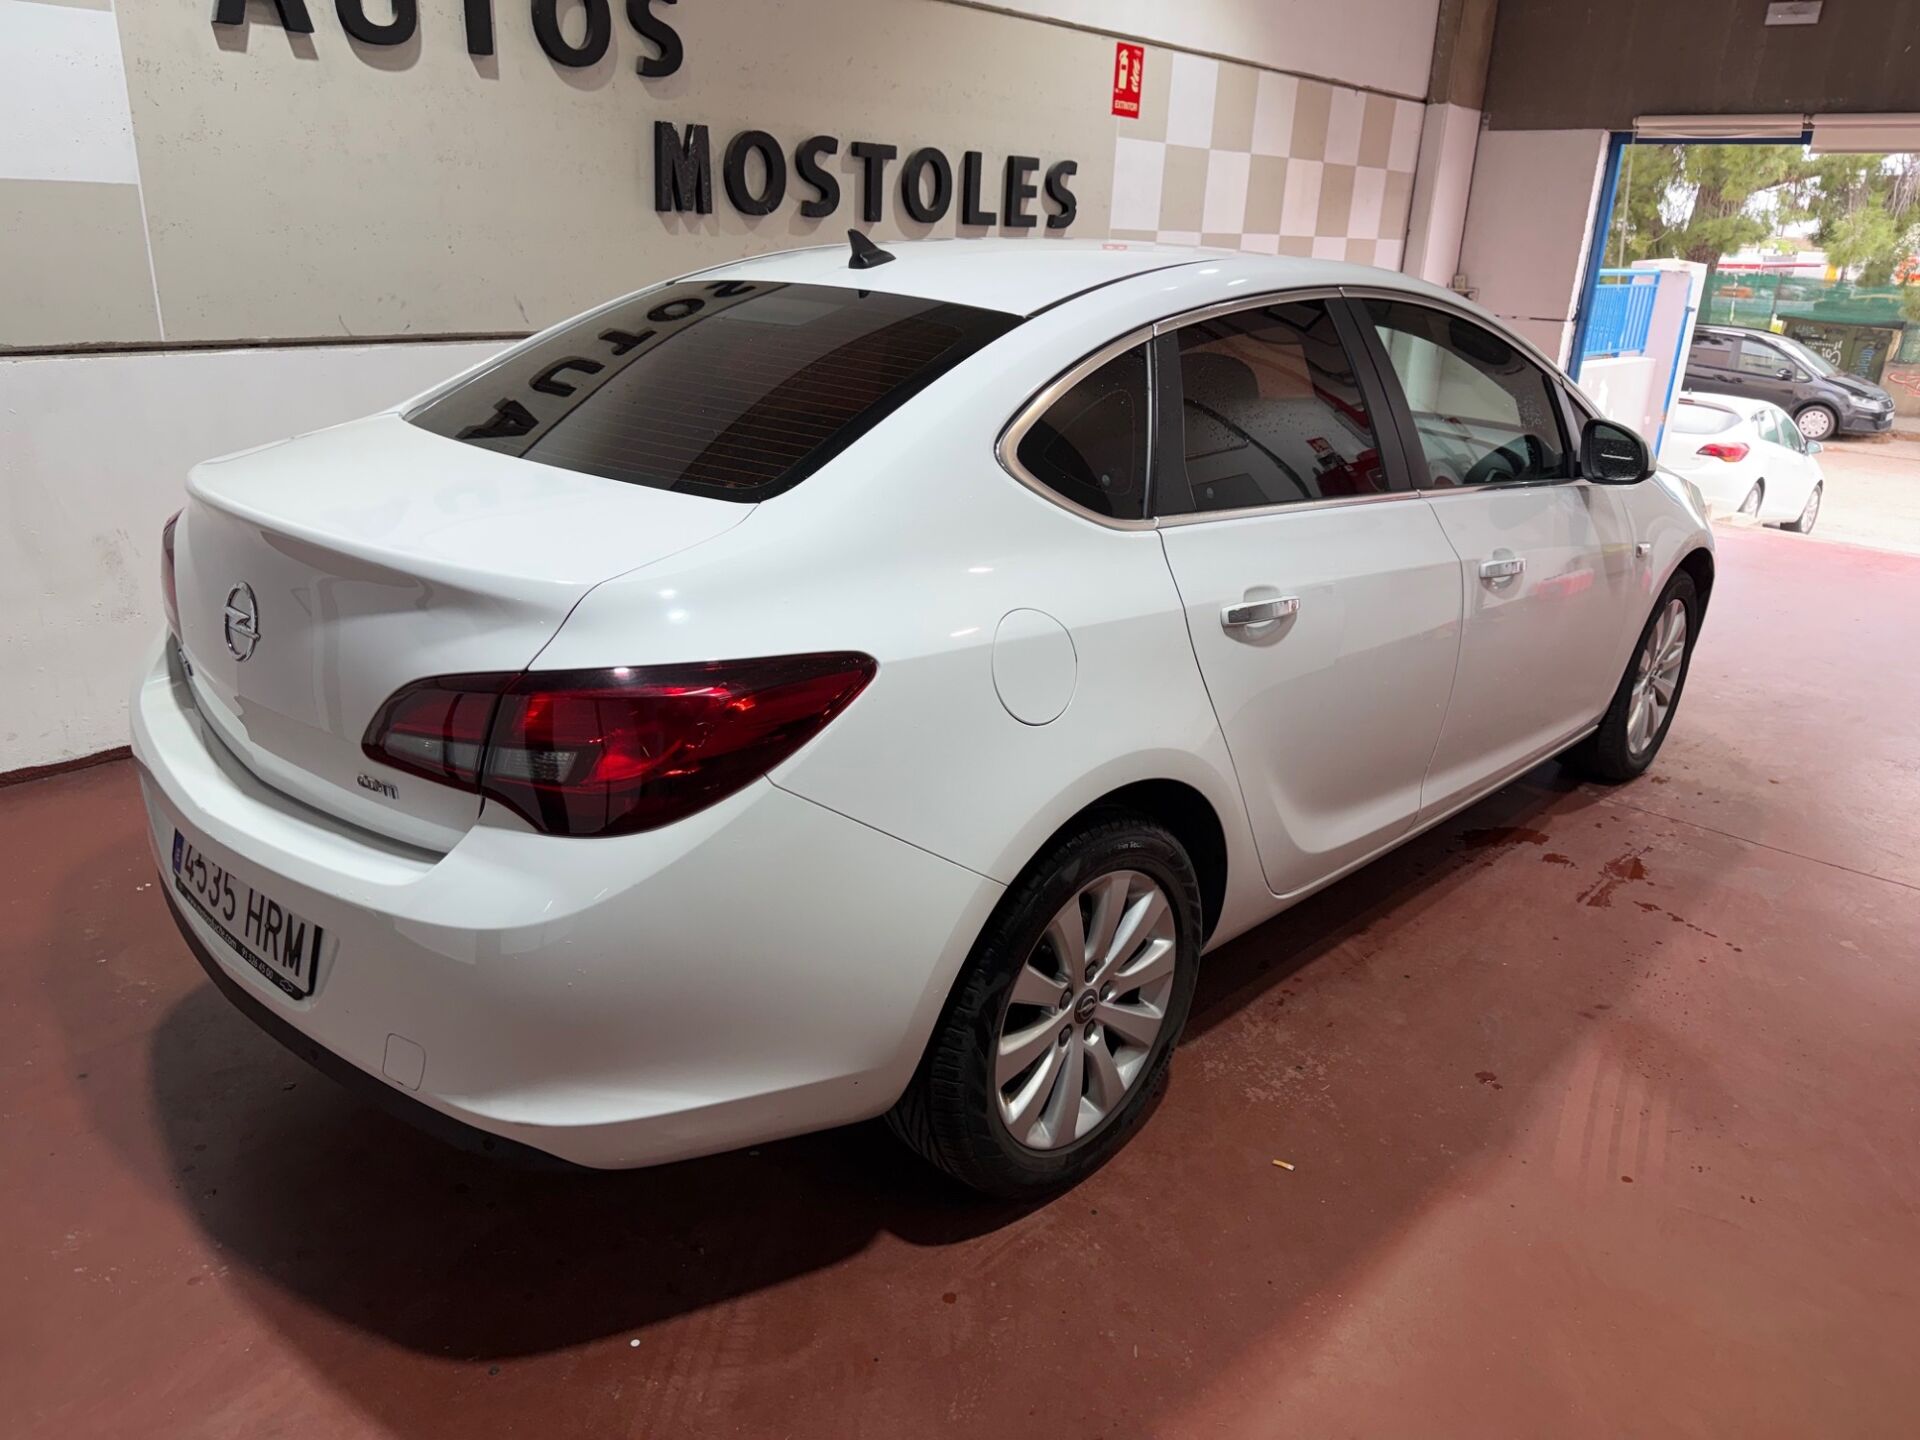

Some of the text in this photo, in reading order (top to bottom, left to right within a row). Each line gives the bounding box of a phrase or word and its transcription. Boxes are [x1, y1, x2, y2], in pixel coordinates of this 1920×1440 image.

[654, 120, 1078, 229] MOSTOLES
[184, 844, 236, 921] 4535
[245, 888, 306, 977] HRM
